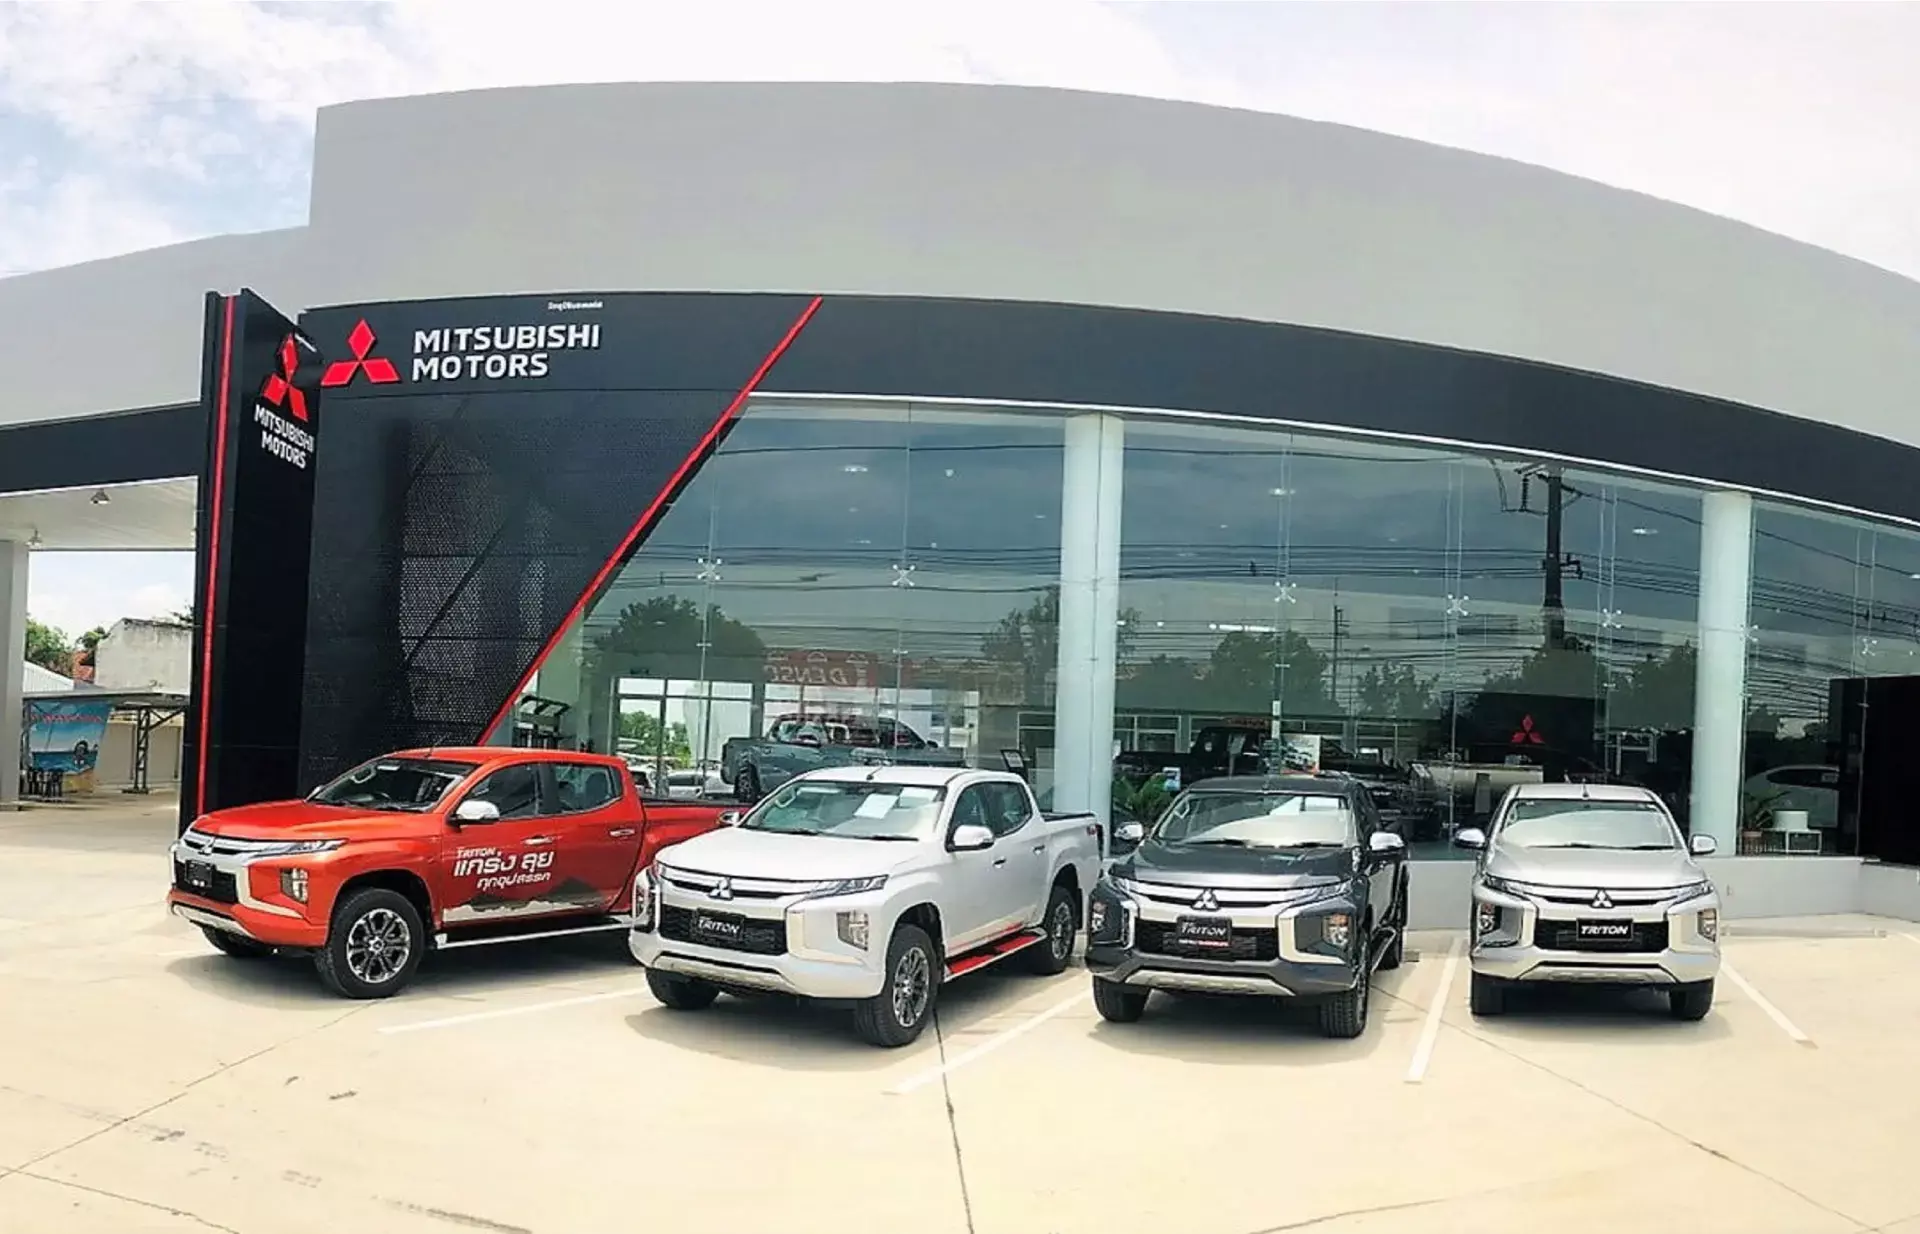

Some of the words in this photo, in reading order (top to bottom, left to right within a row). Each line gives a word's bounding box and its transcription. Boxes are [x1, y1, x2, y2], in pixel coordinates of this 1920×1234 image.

[413, 323, 600, 354] MITSUBISHI
[412, 353, 549, 381] MOTORS
[254, 404, 315, 452] MITSUBISHI
[261, 430, 307, 469] MOTORS
[521, 851, 555, 873] ลุย
[1581, 925, 1629, 935] TRITON
